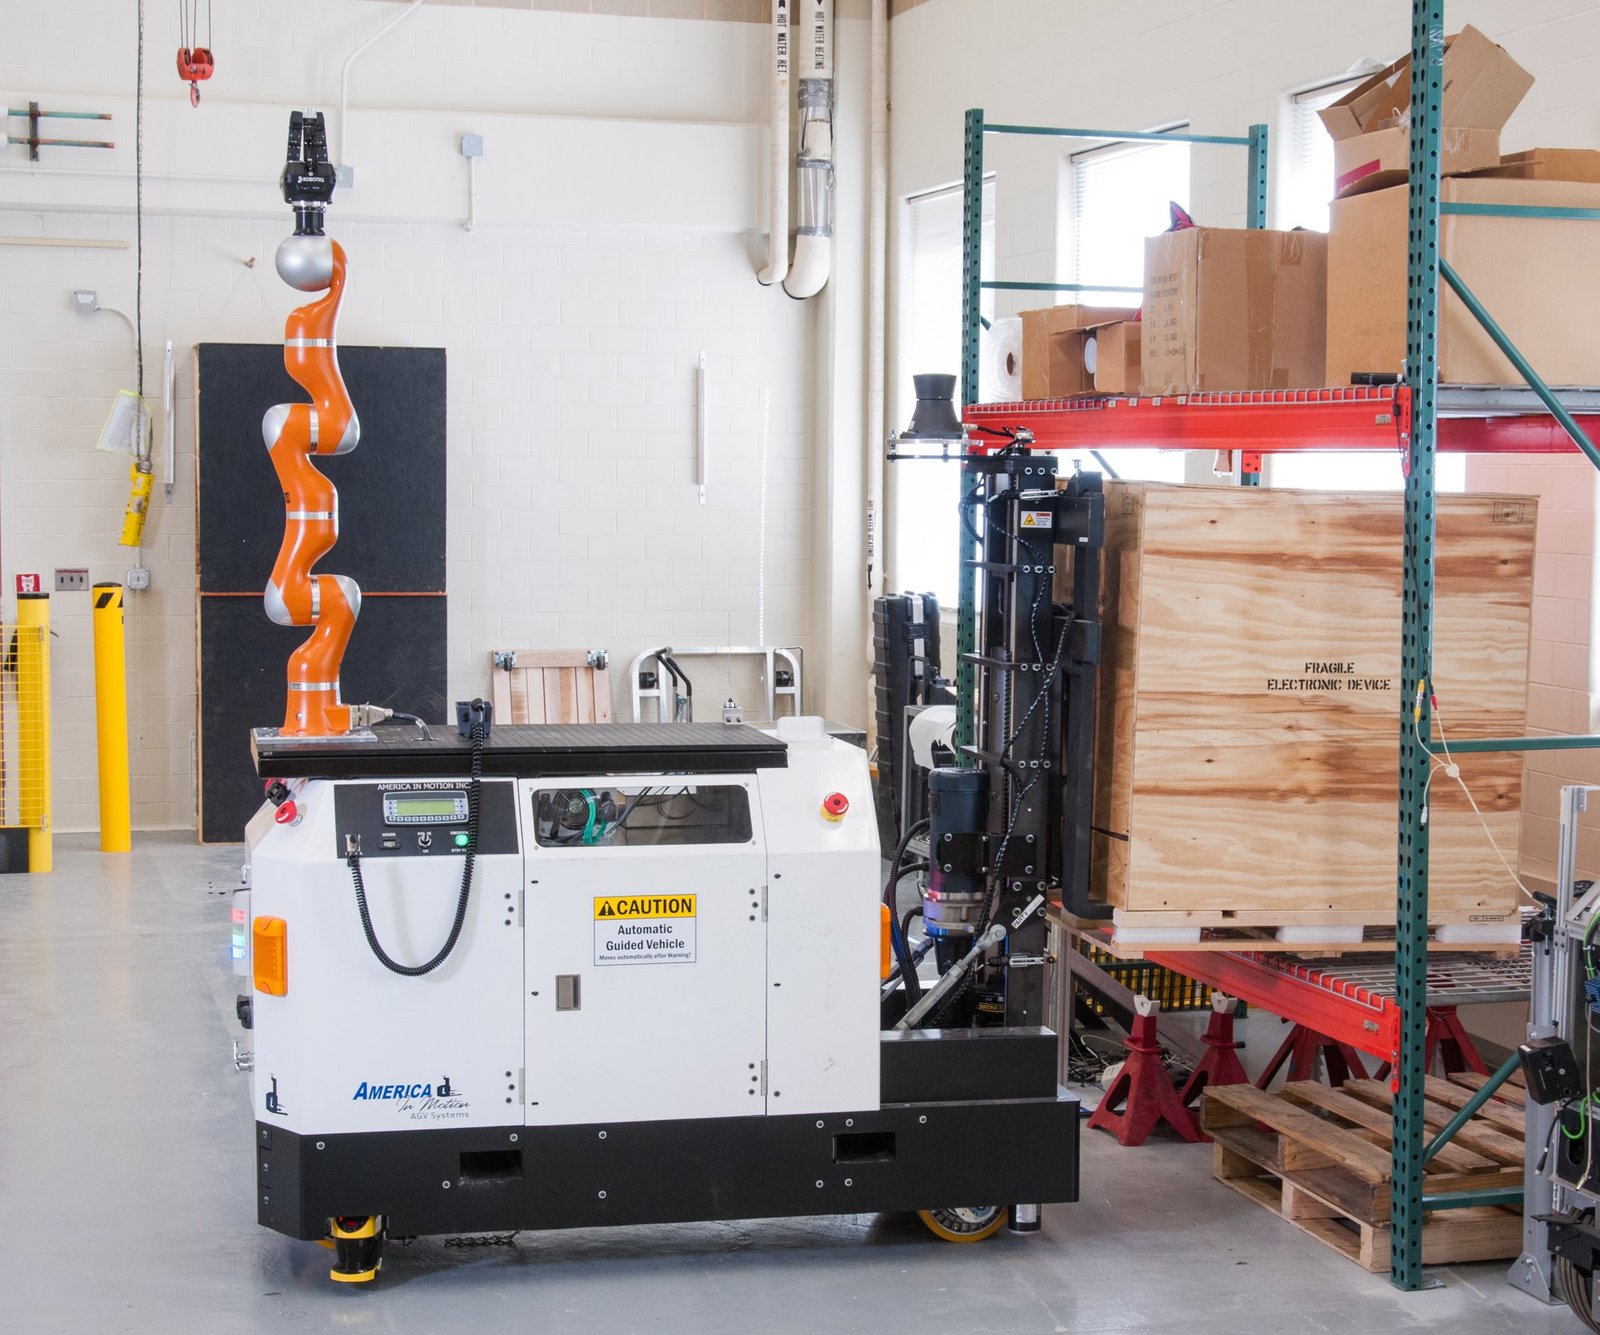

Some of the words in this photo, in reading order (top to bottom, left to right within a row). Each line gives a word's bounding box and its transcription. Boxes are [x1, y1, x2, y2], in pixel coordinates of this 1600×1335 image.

[777, 14, 787, 28] HOT
[814, 11, 824, 22] HOT
[814, 26, 824, 44] WATER
[777, 32, 787, 56] WATER
[814, 46, 824, 70] HEATING
[777, 60, 787, 76] RET.
[1304, 662, 1355, 674] FRAGILE
[1267, 678, 1342, 690] ELECTRONIC
[1347, 678, 1392, 690] DEVICE
[616, 898, 692, 915] CAUTION
[618, 924, 673, 935] Automatic
[606, 940, 644, 951] Guided
[646, 938, 685, 950] Vehicle
[352, 1082, 432, 1100] AMERICA
[396, 1095, 413, 1112] In
[420, 1096, 471, 1112] Motion
[430, 1112, 470, 1120] Systems
